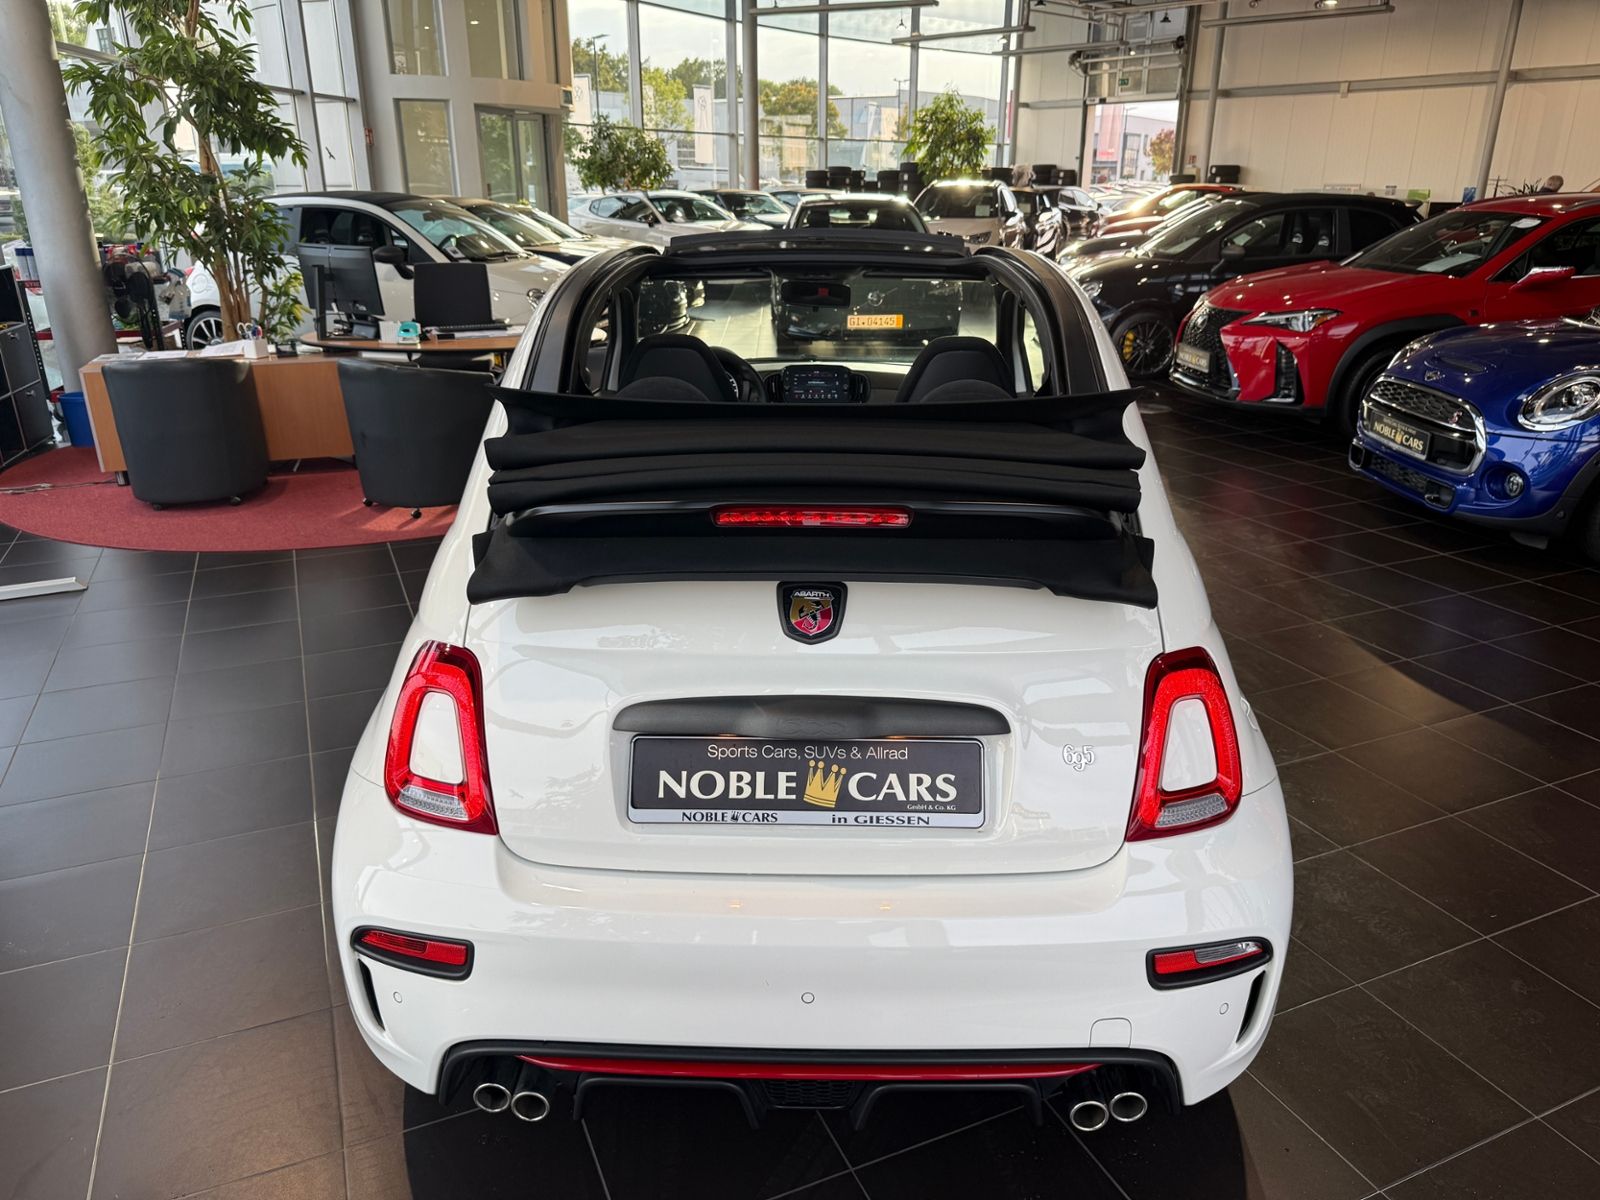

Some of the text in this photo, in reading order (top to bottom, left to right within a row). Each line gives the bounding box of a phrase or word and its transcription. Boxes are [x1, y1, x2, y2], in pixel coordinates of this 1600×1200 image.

[1373, 421, 1396, 438] NOBLE
[1402, 434, 1424, 451] CARS
[794, 590, 830, 598] ABARTH
[707, 744, 909, 760] Sports Cars, SUVs & Allrad
[1062, 743, 1095, 772] 695
[658, 770, 957, 802] NOBLE CARS
[907, 803, 927, 811] GmbH
[681, 811, 930, 826] NOBLE CARS in GIESSEN
